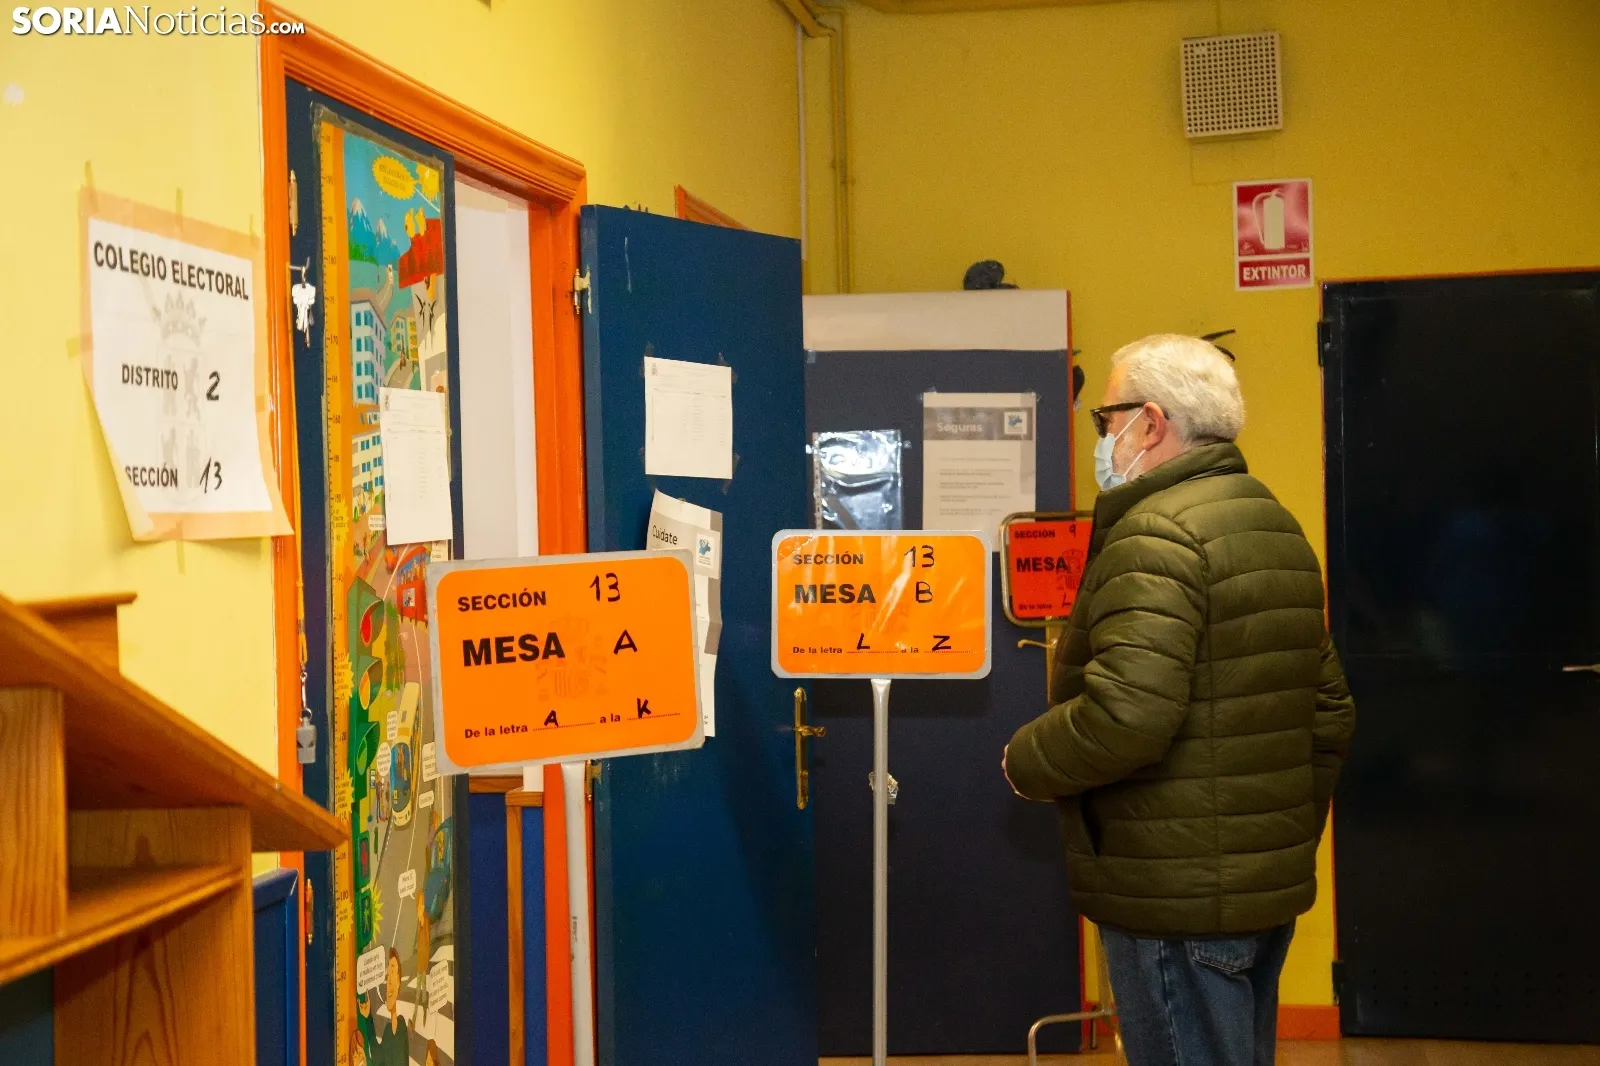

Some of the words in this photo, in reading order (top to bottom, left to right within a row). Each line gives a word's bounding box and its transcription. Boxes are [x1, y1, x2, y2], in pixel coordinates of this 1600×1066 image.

[93, 241, 167, 281] COLEGIO
[171, 260, 249, 301] ELECTORAL
[1243, 264, 1306, 281] EXTINTOR
[121, 363, 179, 390] DISTRITO
[206, 371, 220, 401] 2
[125, 462, 178, 488] SECCIÓN
[199, 456, 223, 494] 13
[793, 551, 864, 565] SECCIÓN
[904, 545, 935, 568] 13
[1016, 557, 1069, 572] MESA
[457, 588, 547, 612] SECCIÓN
[589, 572, 621, 602] 13
[794, 583, 876, 604] MESA
[915, 581, 933, 603] B
[462, 632, 566, 667] MESA
[613, 629, 638, 655] A
[792, 646, 805, 654] De
[808, 646, 817, 654] la
[820, 646, 843, 654] letra
[856, 633, 870, 650] L
[910, 646, 919, 654] la
[932, 635, 952, 652] Z
[464, 728, 480, 738] De
[484, 726, 496, 736] la
[499, 724, 528, 735] letra
[543, 709, 559, 728] A
[600, 715, 607, 724] a
[610, 712, 621, 723] la
[637, 698, 652, 719] K
